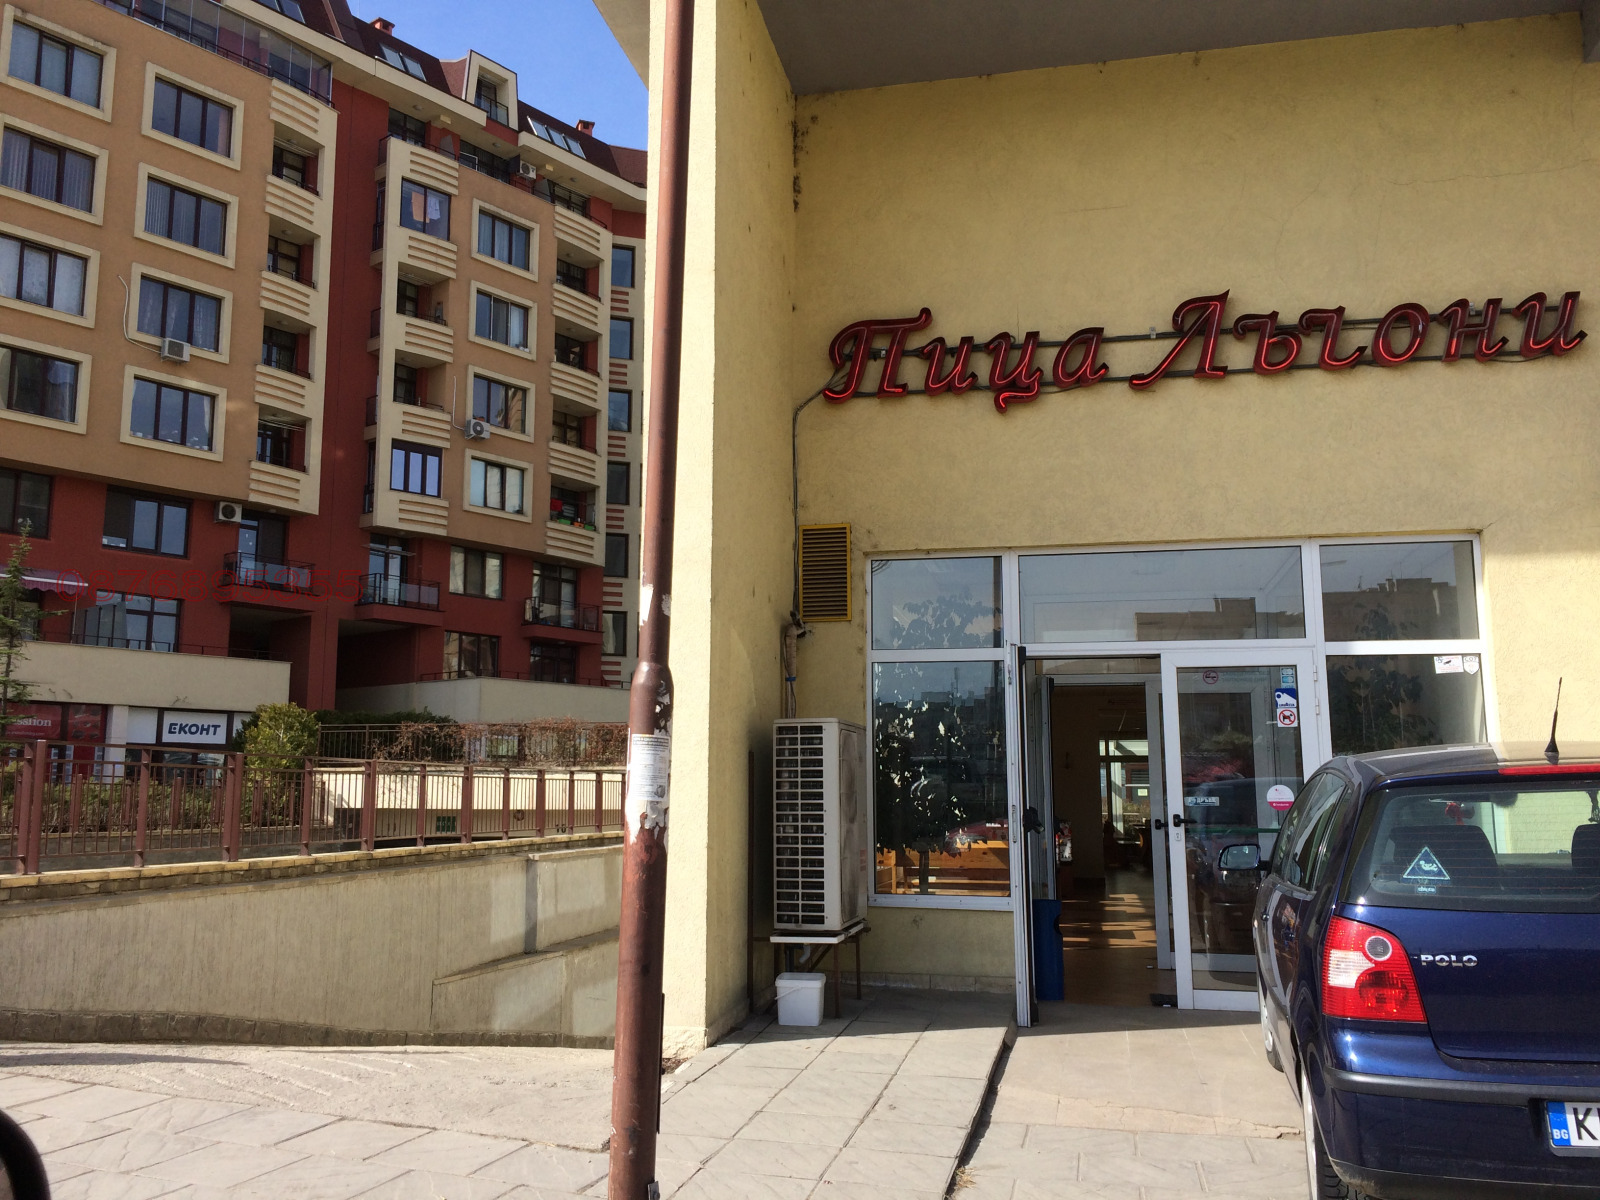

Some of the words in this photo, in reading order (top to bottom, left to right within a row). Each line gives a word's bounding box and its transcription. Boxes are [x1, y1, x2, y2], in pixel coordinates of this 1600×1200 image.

[822, 307, 1109, 413] Пица
[168, 723, 221, 735] ЕКОНТ
[1420, 954, 1478, 967] POLO
[1572, 1107, 1600, 1140] K
[1553, 1129, 1569, 1140] BG
